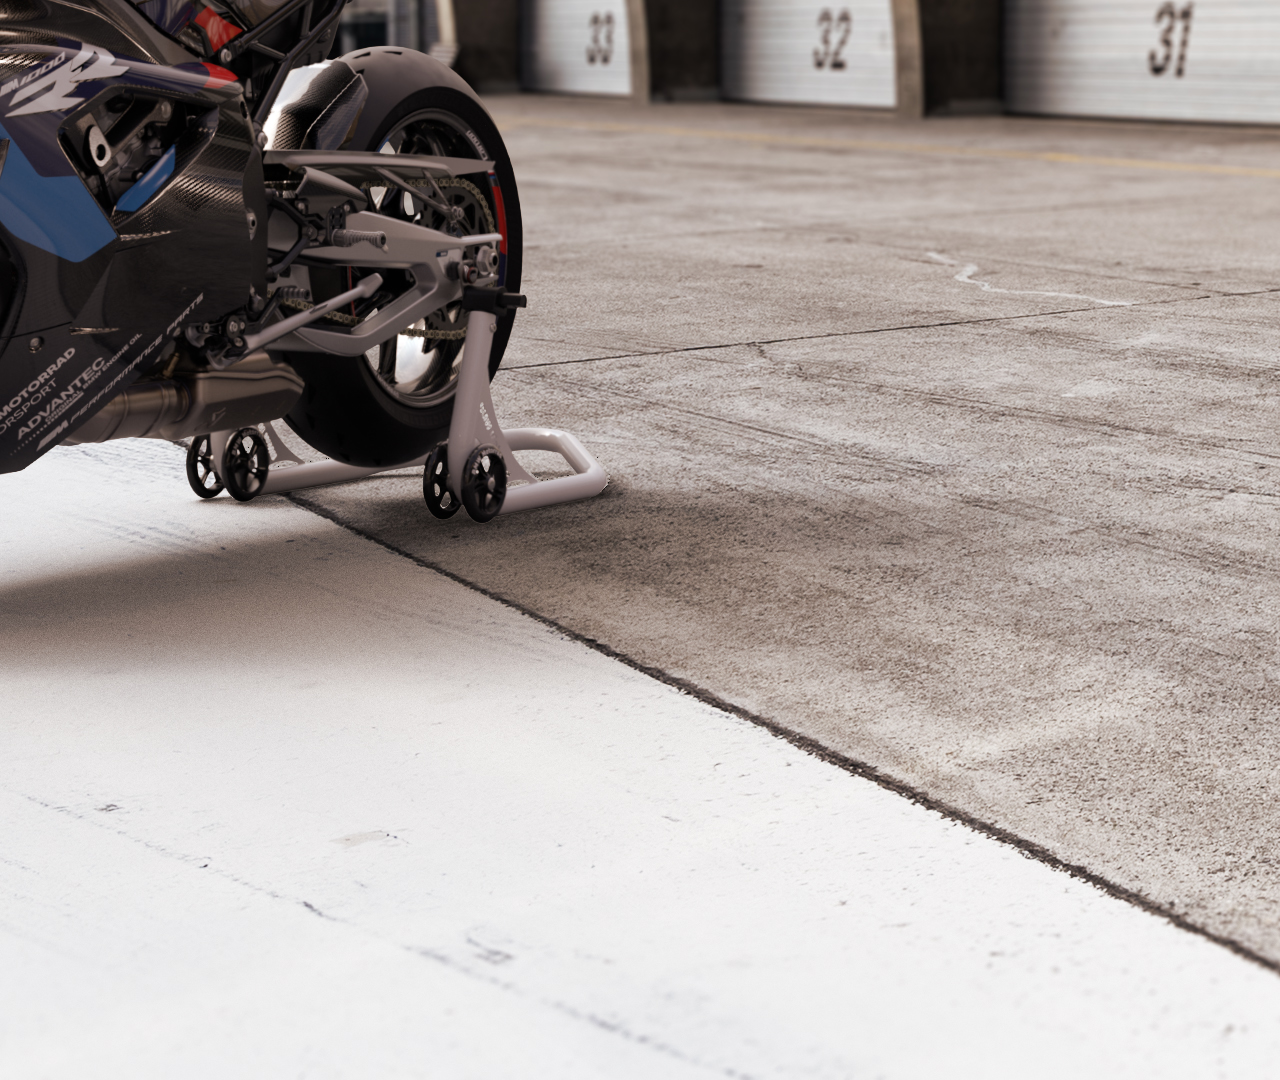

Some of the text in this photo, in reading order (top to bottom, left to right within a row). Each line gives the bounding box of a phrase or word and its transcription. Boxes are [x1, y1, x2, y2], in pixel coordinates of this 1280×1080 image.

[585, 10, 615, 66] 33
[812, 7, 853, 72] 32
[1147, 0, 1195, 79] 31
[18, 356, 106, 440] ADVANTEC
[44, 332, 143, 423] ORIGINAL BMW ENGINE OIL
[70, 333, 163, 424] PERFORMANCE
[166, 292, 204, 335] PARTS
